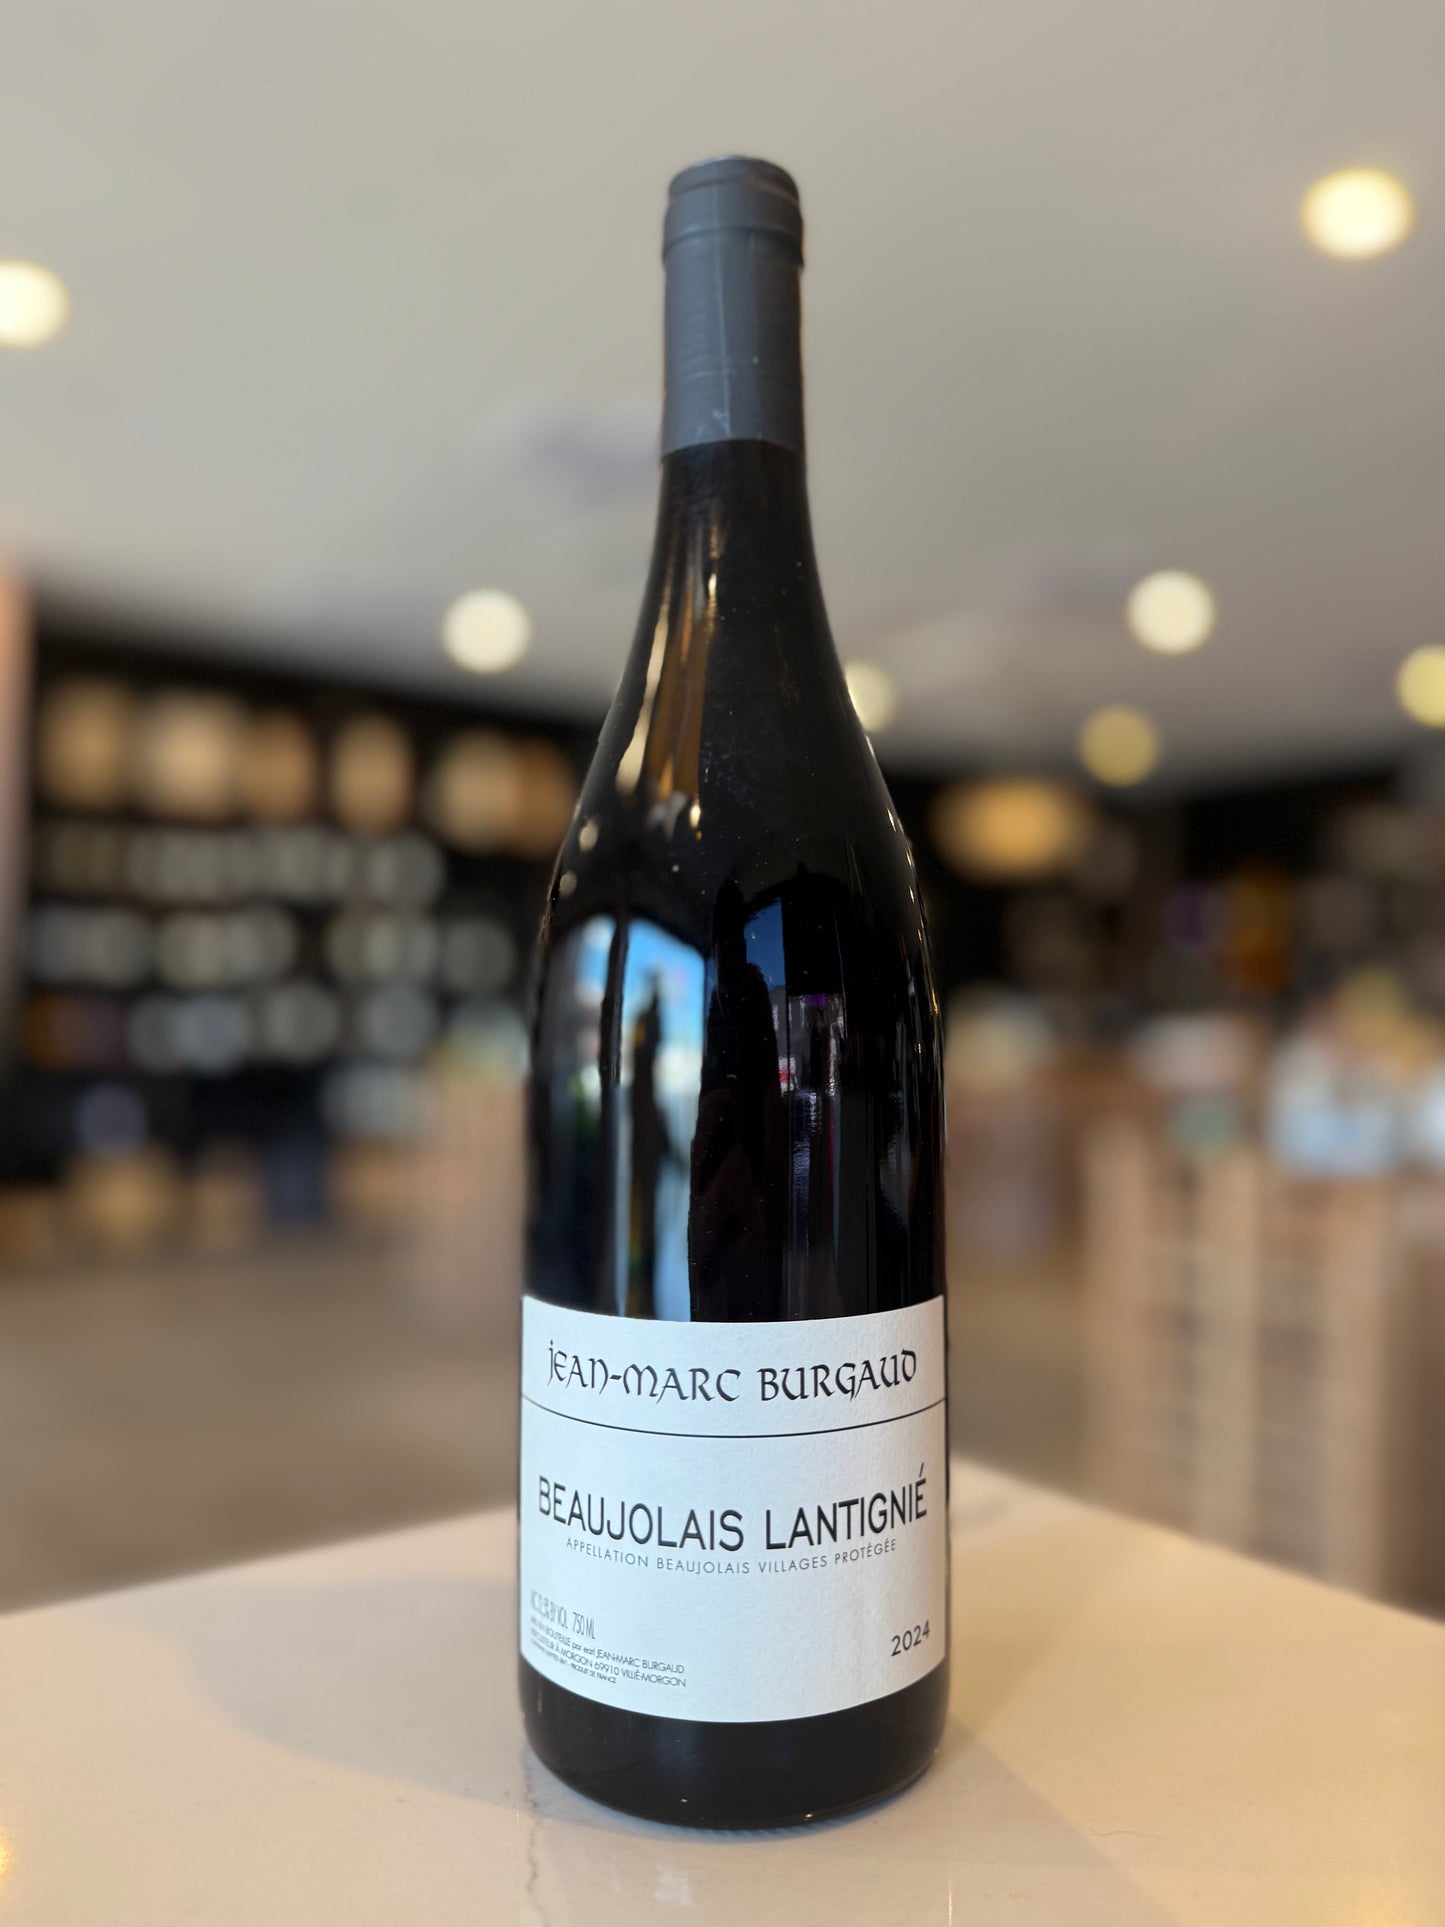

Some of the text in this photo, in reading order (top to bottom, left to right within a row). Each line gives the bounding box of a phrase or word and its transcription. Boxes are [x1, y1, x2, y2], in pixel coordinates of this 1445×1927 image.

[756, 1347, 918, 1403] BURGAUD
[538, 1461, 928, 1552] BEAUJOLAIS LANTIGNIÉ
[566, 1537, 897, 1574] APPELLATION BEAUJOLAIS VILLAGES PROTÉGÉE
[572, 1611, 585, 1636] 750
[586, 1616, 596, 1640] ML
[891, 1619, 930, 1657] 2024
[560, 1647, 593, 1668] MORGON
[594, 1661, 620, 1676] 69910
[596, 1649, 640, 1668] JEAN-MARC
[642, 1659, 685, 1674] BURGAUD
